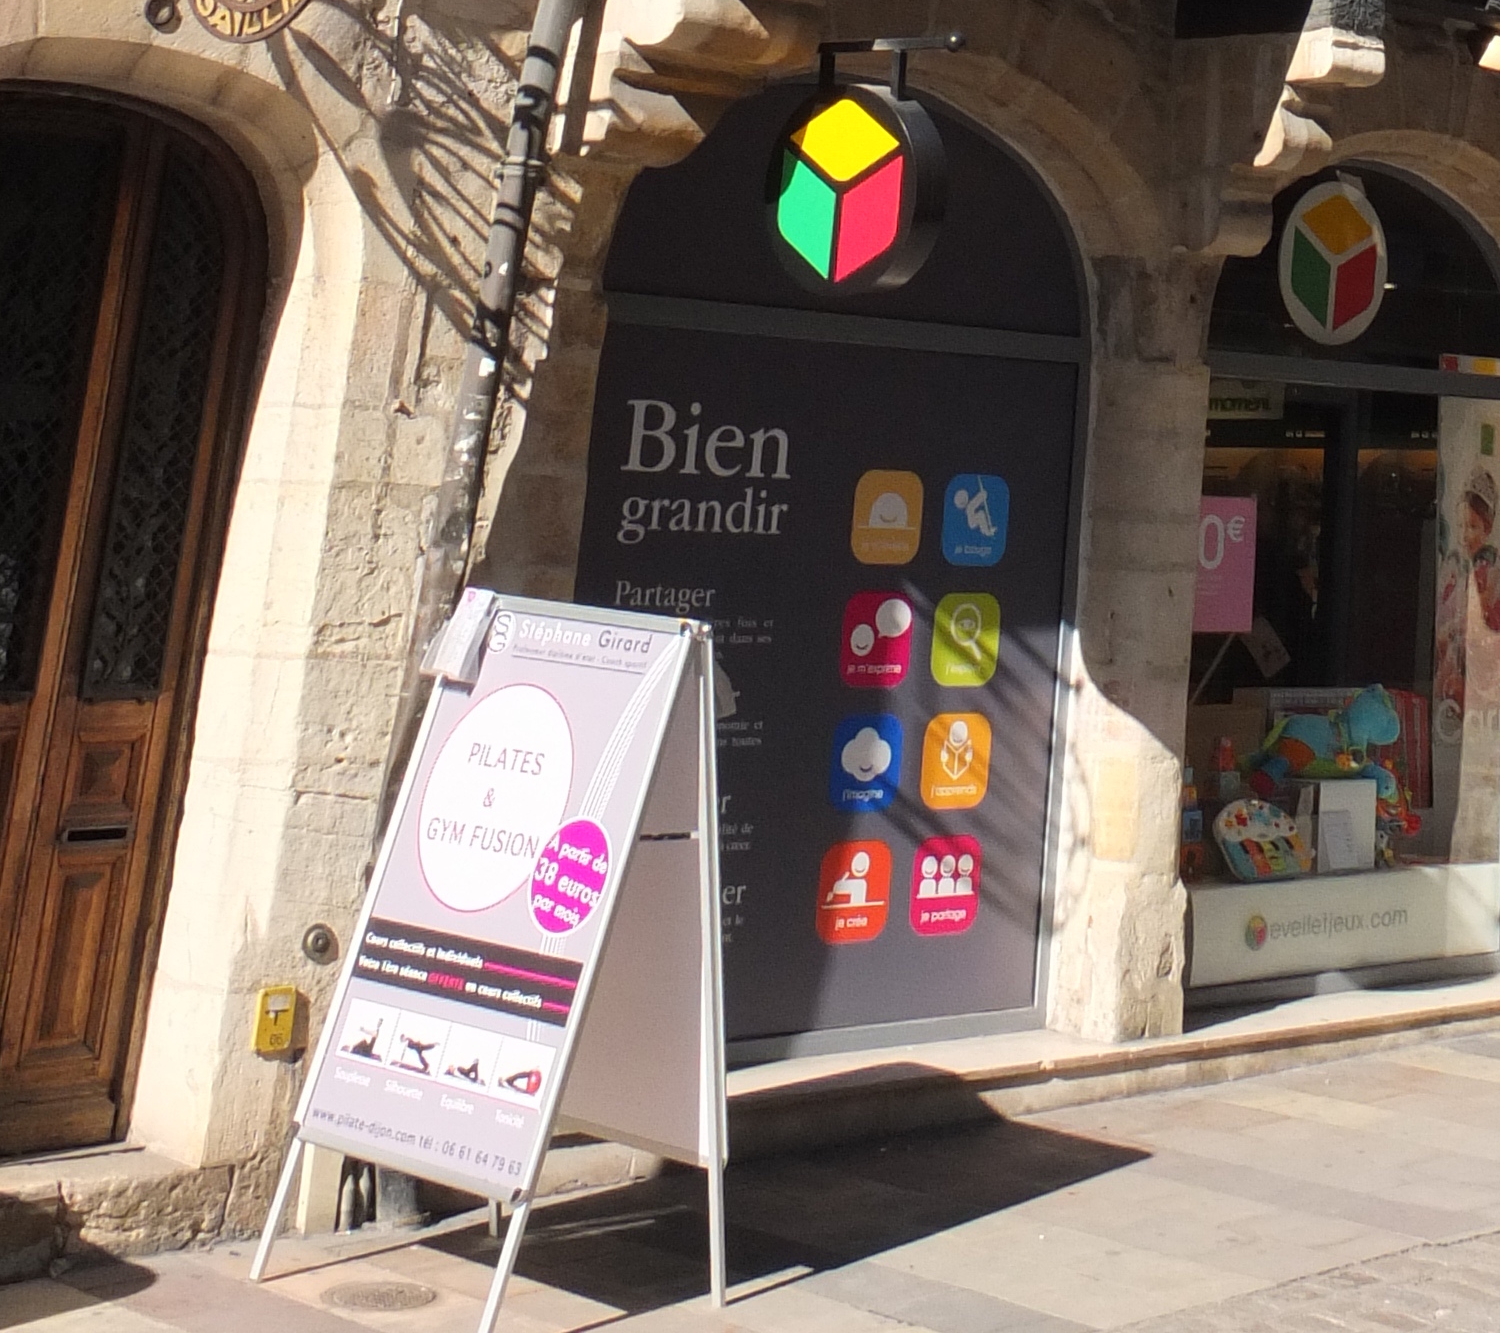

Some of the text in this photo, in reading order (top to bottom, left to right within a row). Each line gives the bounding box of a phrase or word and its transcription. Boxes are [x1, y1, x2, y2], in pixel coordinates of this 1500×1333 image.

[620, 399, 791, 479] Bien
[616, 486, 790, 544] grandir
[615, 580, 716, 614] Partager
[518, 618, 653, 654] Stéphane Girard
[467, 742, 546, 776] PILATES
[482, 788, 495, 807] &
[426, 817, 540, 859] GYM FUSION
[558, 843, 593, 866] partir
[591, 853, 608, 874] de
[534, 858, 601, 907] 38 euros
[533, 894, 554, 912] par
[311, 1108, 416, 1146] www.pilate-dijon.com
[441, 1140, 456, 1157] 06
[458, 1145, 471, 1162] 61
[474, 1150, 488, 1166] 64
[490, 1155, 506, 1172] 79
[507, 1160, 523, 1176] 63
